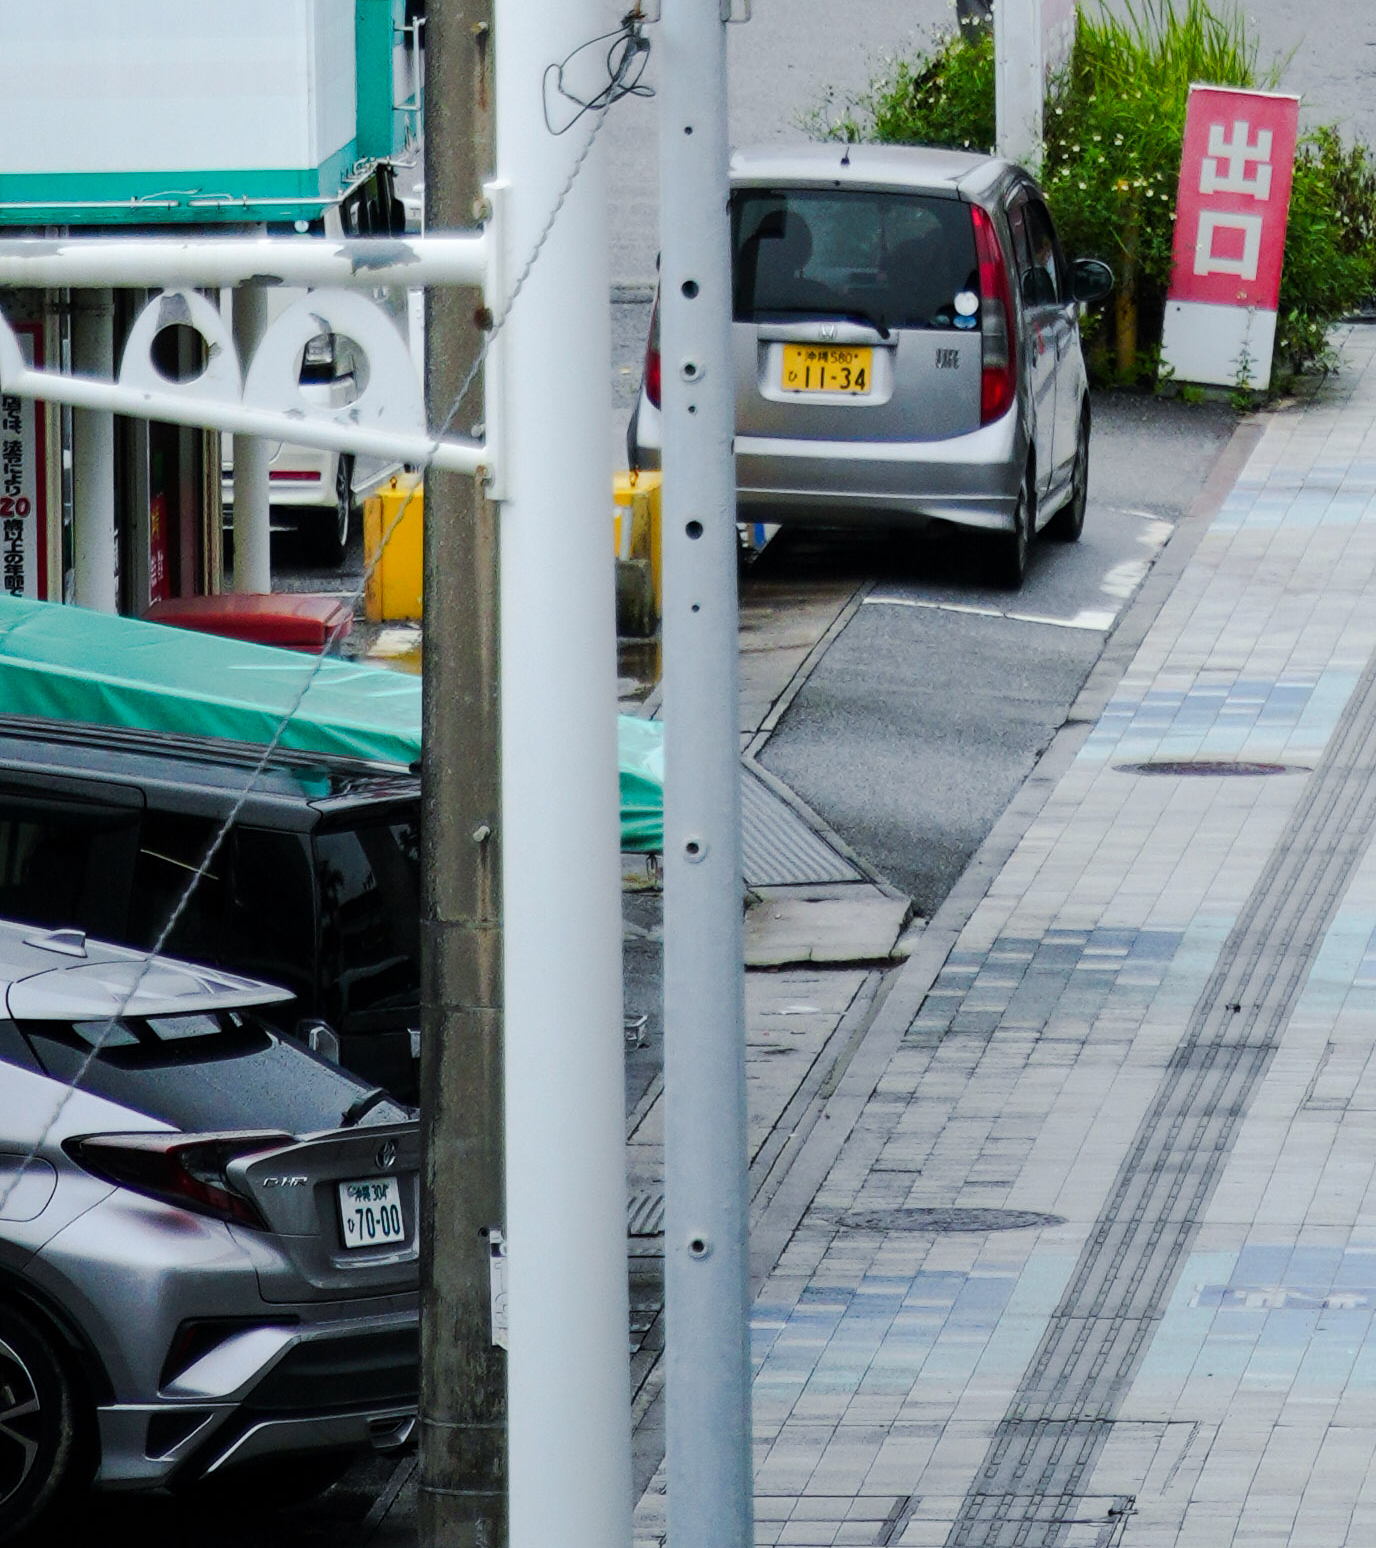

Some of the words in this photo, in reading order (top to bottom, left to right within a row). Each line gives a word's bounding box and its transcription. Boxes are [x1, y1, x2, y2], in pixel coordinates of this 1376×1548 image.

[1193, 120, 1273, 281] 出口
[805, 366, 866, 390] 11-34
[355, 1203, 402, 1242] 70-00
